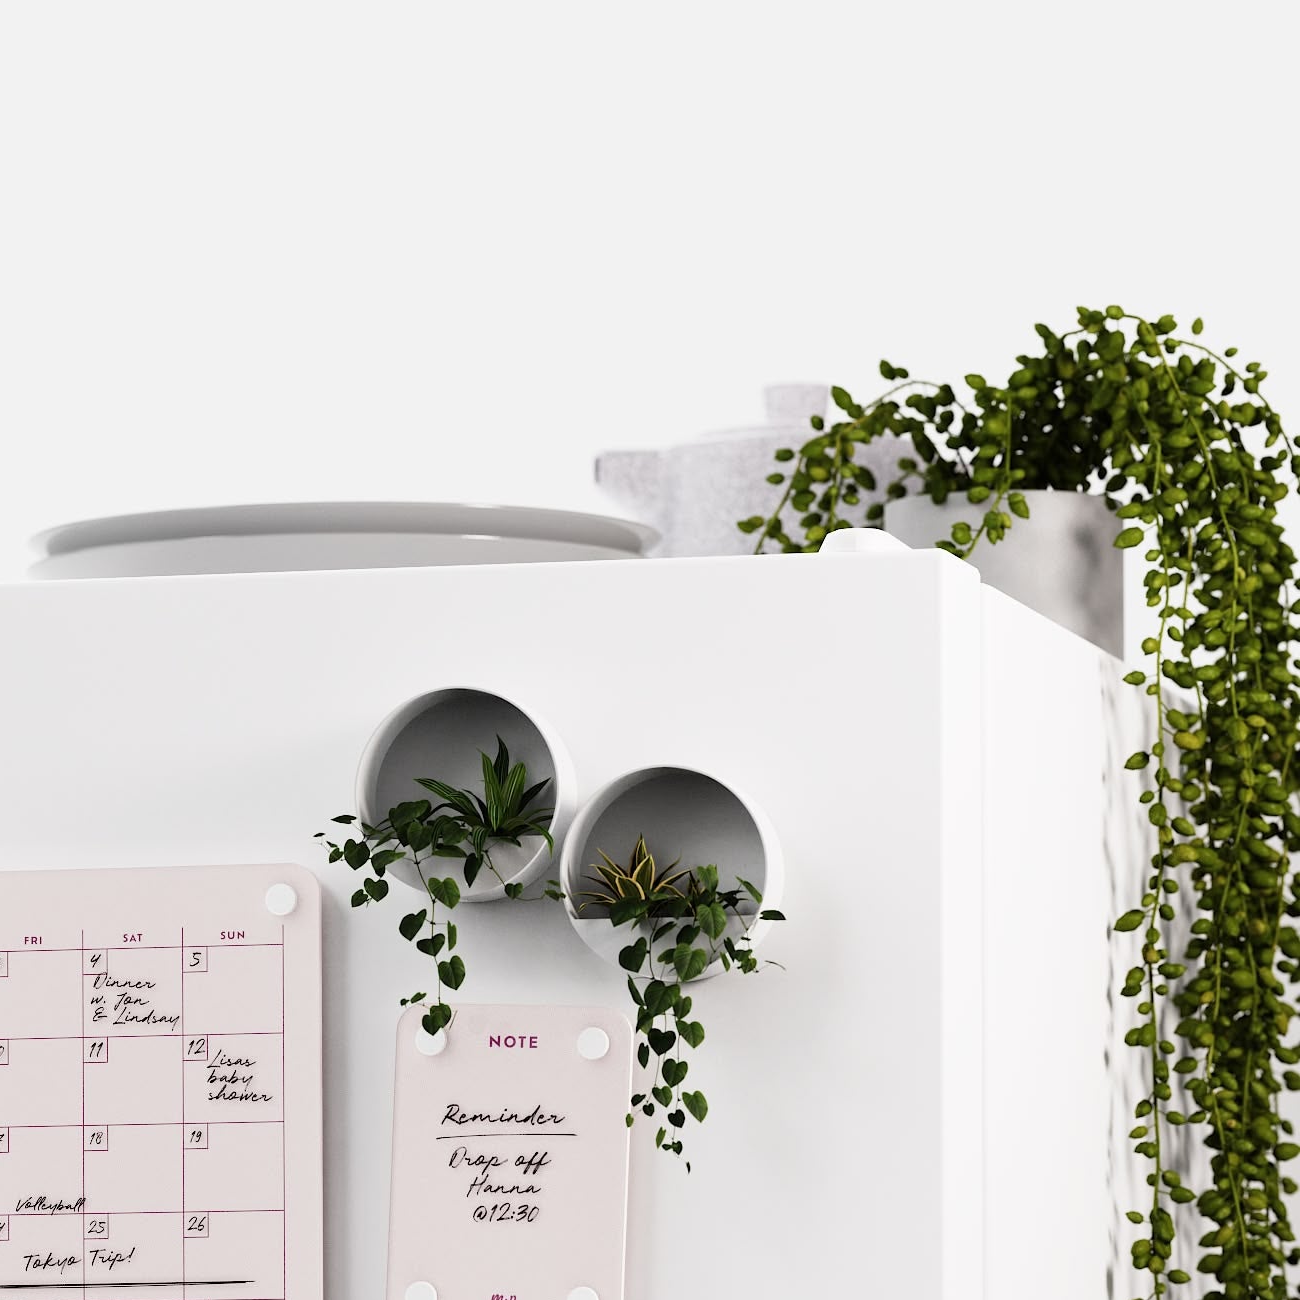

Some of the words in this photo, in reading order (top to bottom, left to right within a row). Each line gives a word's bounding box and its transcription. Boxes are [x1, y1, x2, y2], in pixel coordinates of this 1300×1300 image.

[24, 936, 43, 945] FRI
[123, 933, 143, 942] SAT
[220, 931, 245, 940] SUN
[90, 954, 101, 967] 4
[190, 952, 201, 966] 5
[93, 972, 155, 989] Dinner
[90, 996, 106, 1005] w.
[114, 992, 150, 1010] Jon
[113, 1004, 180, 1031] Lindsay
[89, 1042, 103, 1057] 11
[188, 1039, 206, 1055] 12
[489, 1036, 539, 1049] NOTE
[207, 1049, 256, 1068] Lisas
[207, 1069, 253, 1092] baby
[208, 1085, 273, 1102] shower
[441, 1104, 566, 1126] Reminder
[90, 1132, 103, 1144] 18
[190, 1130, 202, 1143] 19
[448, 1147, 508, 1175] Drop
[515, 1151, 552, 1174] off
[467, 1174, 541, 1197] Hanna
[14, 1196, 87, 1215] Volleyball
[472, 1203, 540, 1223] @12:30
[88, 1221, 106, 1234] 25
[188, 1217, 205, 1231] 26
[23, 1254, 82, 1275] Tokyo
[90, 1247, 136, 1271] Trip!
